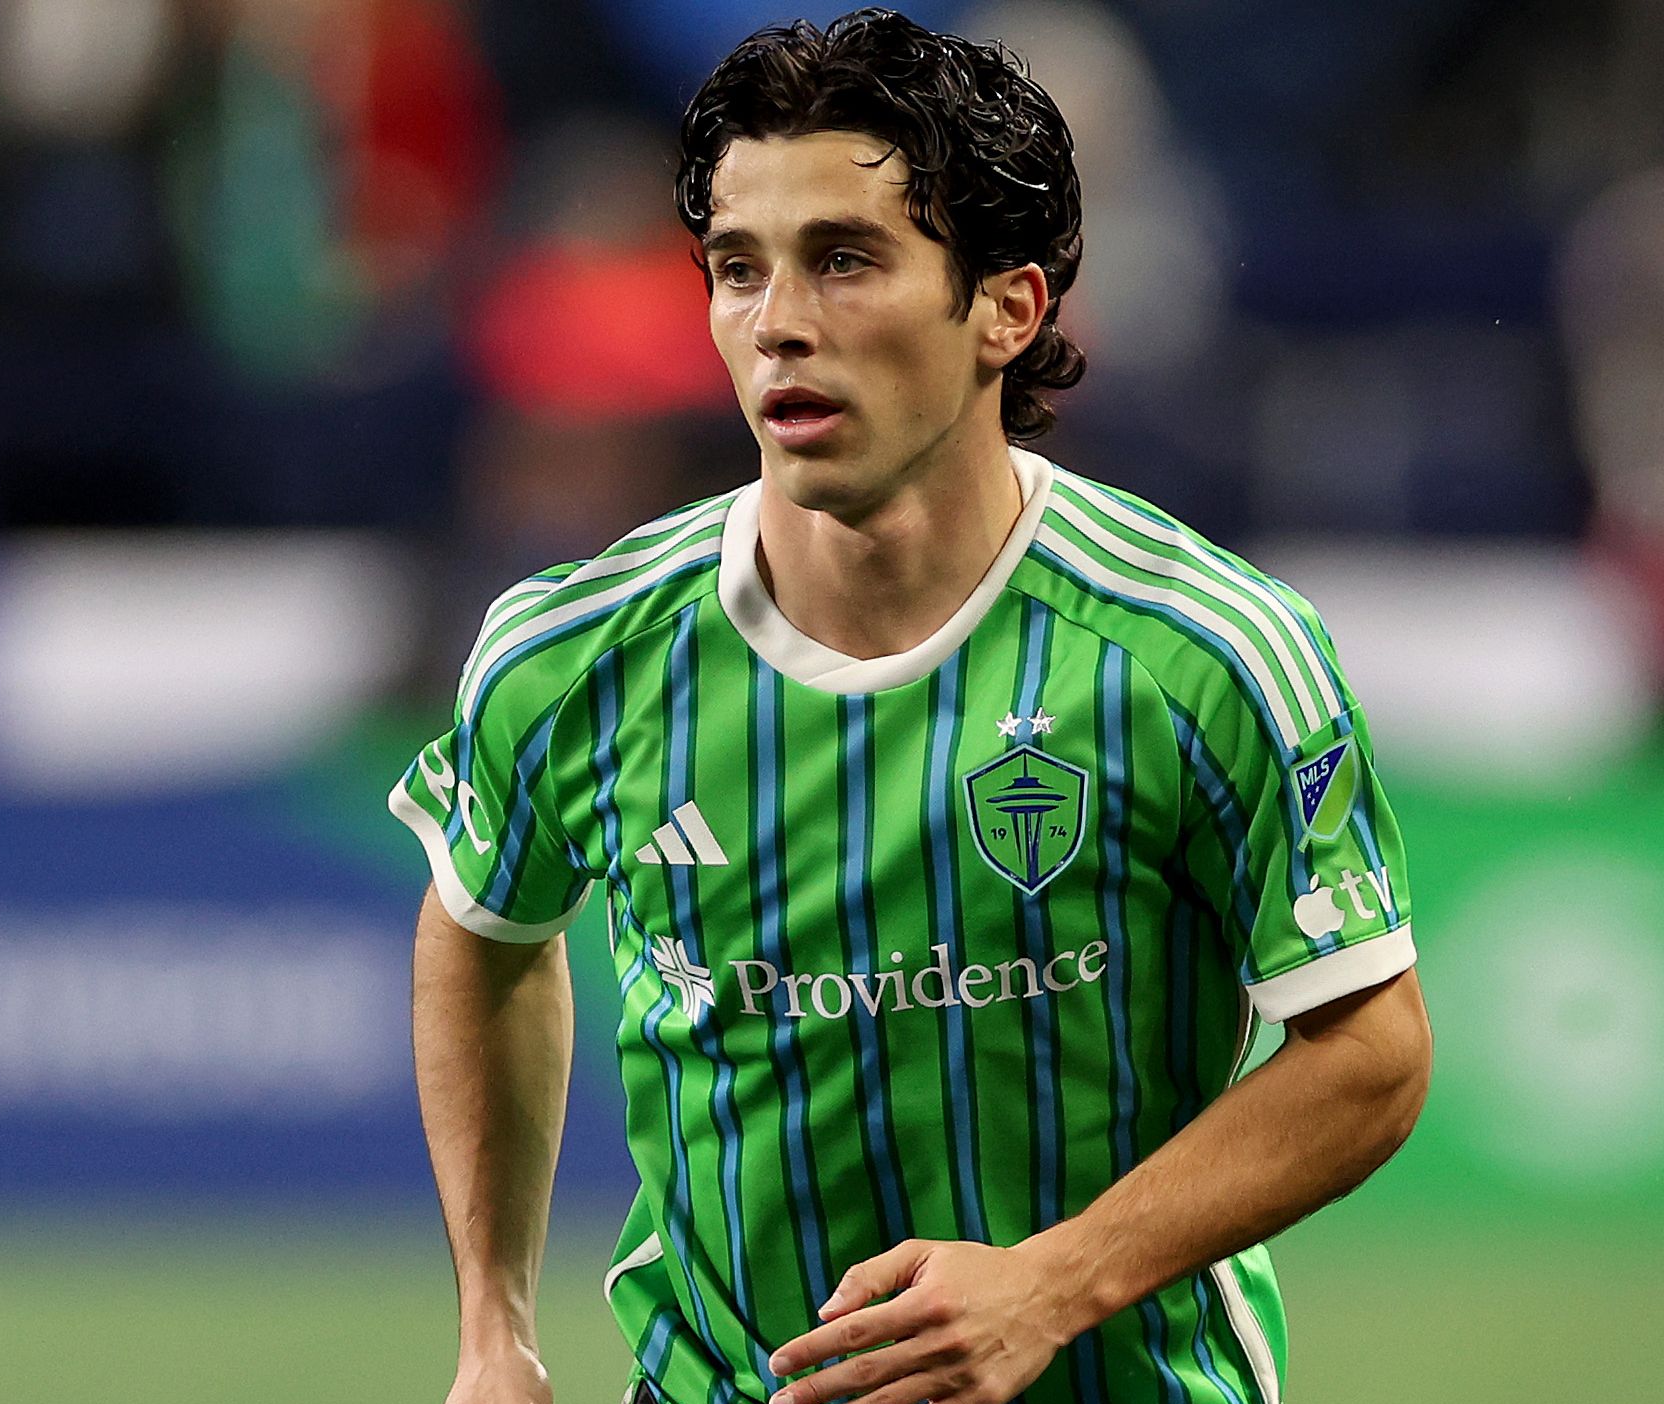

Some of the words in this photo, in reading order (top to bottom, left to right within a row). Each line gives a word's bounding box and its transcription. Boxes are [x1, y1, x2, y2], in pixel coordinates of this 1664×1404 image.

[1300, 757, 1330, 790] MLS
[991, 827, 1007, 840] 19
[1049, 825, 1067, 838] 74
[1339, 866, 1392, 919] tv
[728, 940, 1108, 1019] Providence
